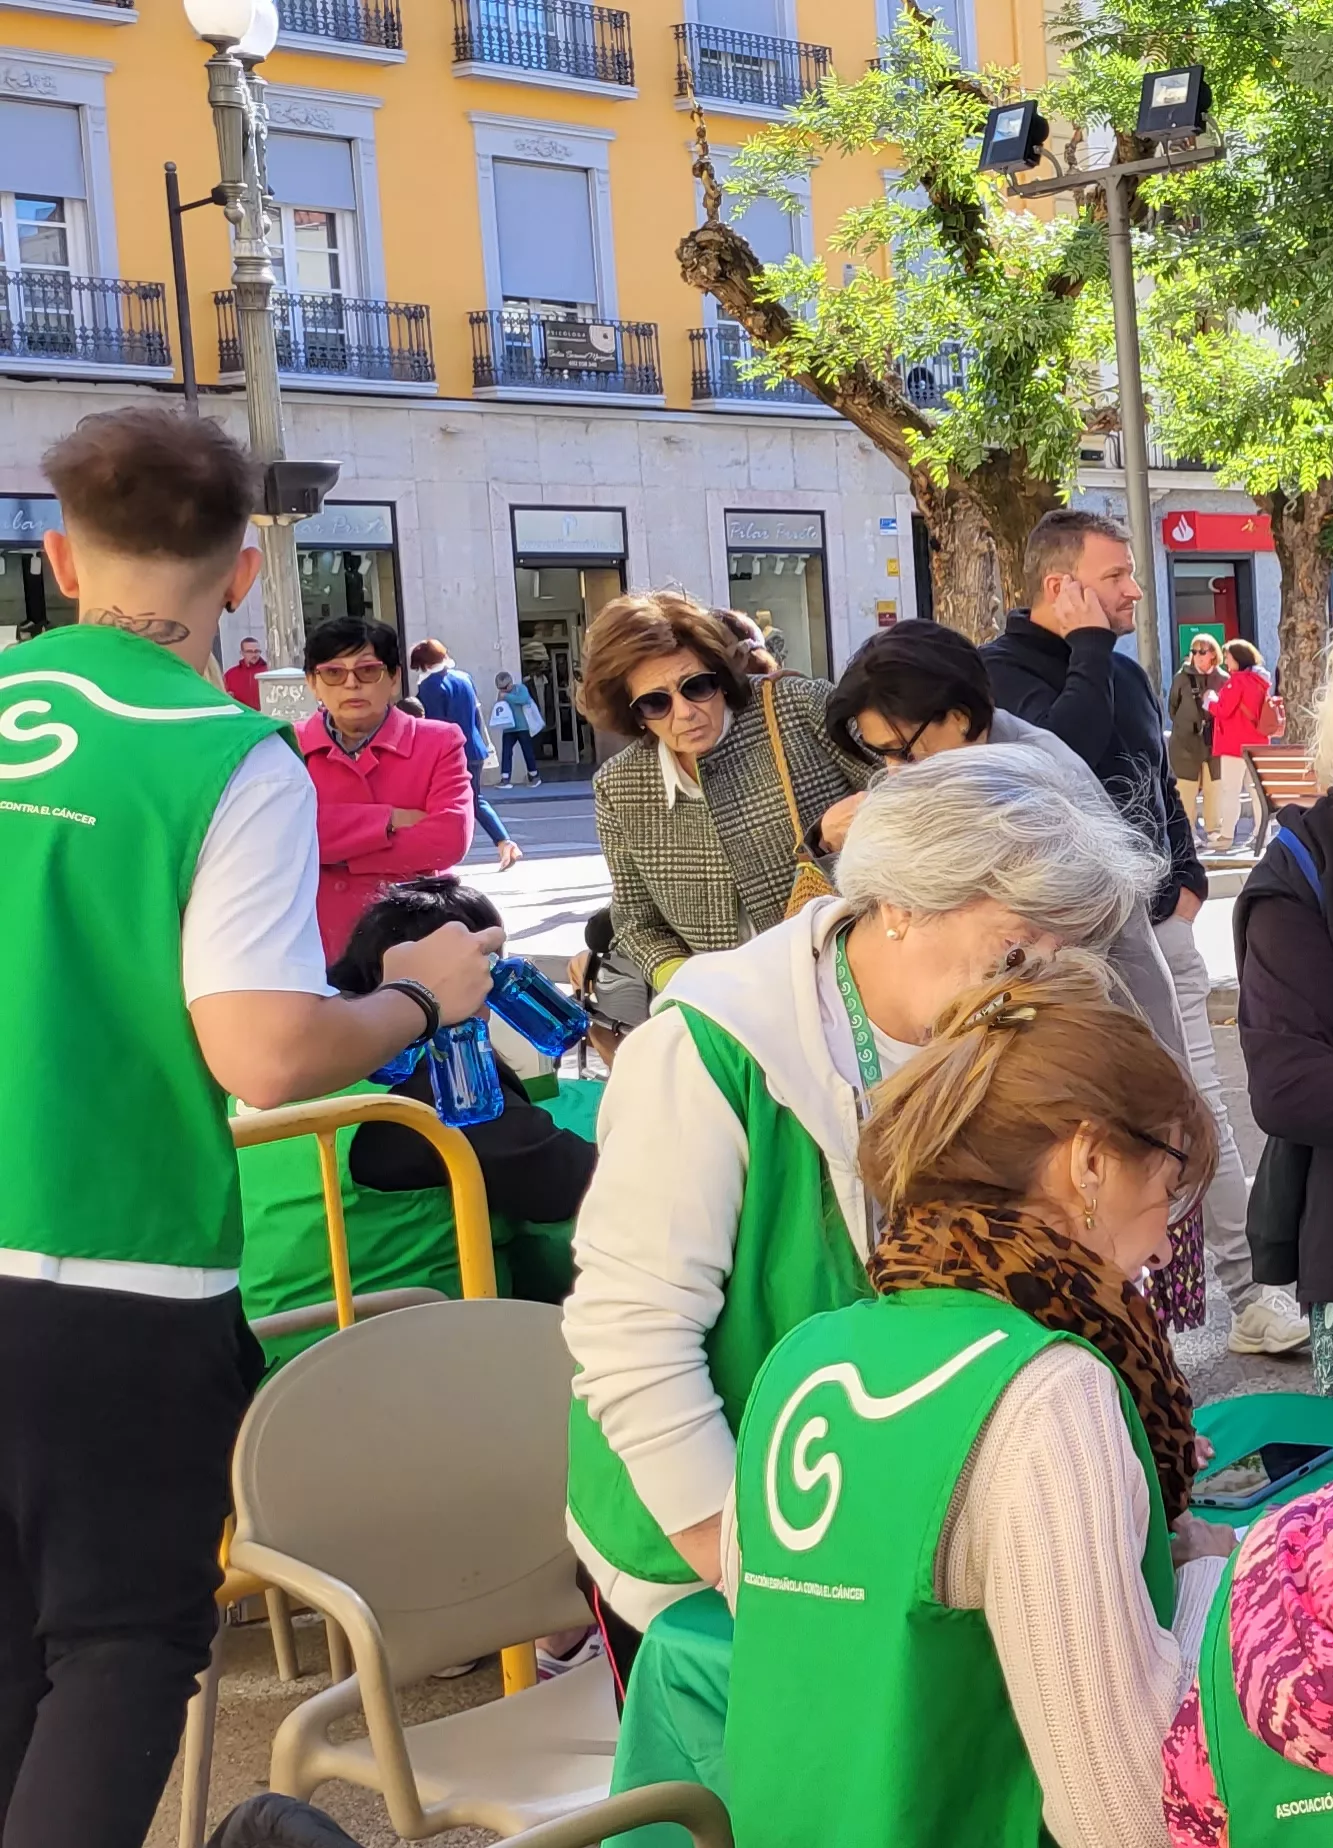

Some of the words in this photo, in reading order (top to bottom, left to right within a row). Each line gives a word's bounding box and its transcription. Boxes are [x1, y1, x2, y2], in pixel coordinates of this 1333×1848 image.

[0, 801, 40, 814] CONTRA
[40, 805, 51, 816] EL
[52, 807, 96, 826] CÁNCER
[832, 1584, 865, 1601] CÁNCER
